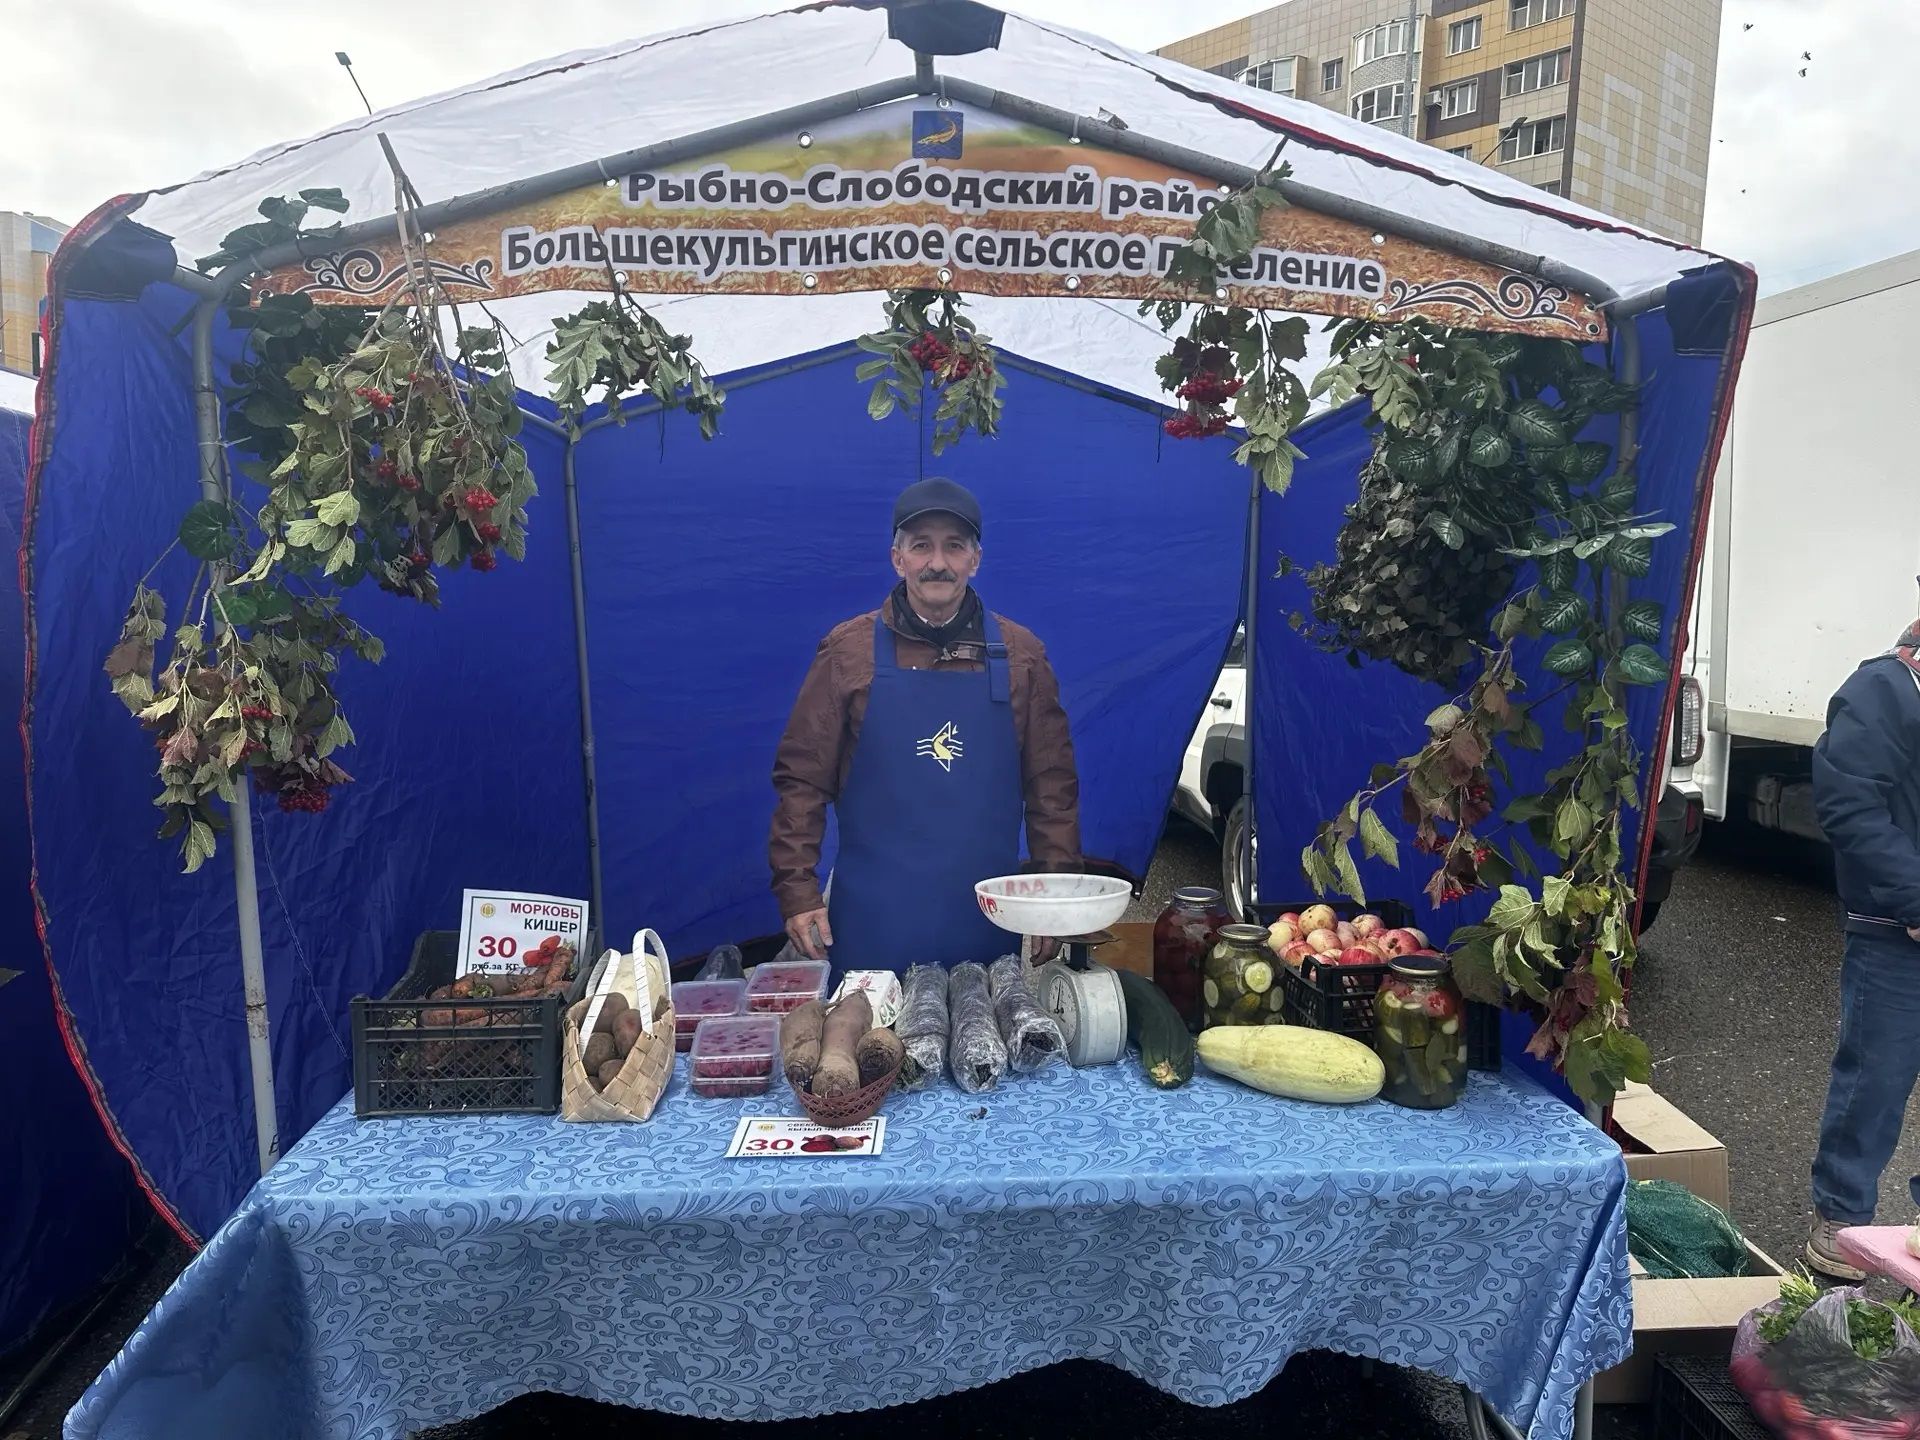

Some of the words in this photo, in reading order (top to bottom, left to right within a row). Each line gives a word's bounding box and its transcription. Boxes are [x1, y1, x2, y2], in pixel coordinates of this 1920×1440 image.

[627, 164, 1094, 208] Рыбно-Слободский
[1108, 183, 1222, 216] райо
[507, 228, 944, 277] Большекульгинское
[955, 232, 1146, 270] сельское
[510, 902, 579, 919] МОРКОВЬ
[523, 917, 578, 934] КИШЕР
[478, 936, 517, 958] 30
[746, 1139, 794, 1150] 30
